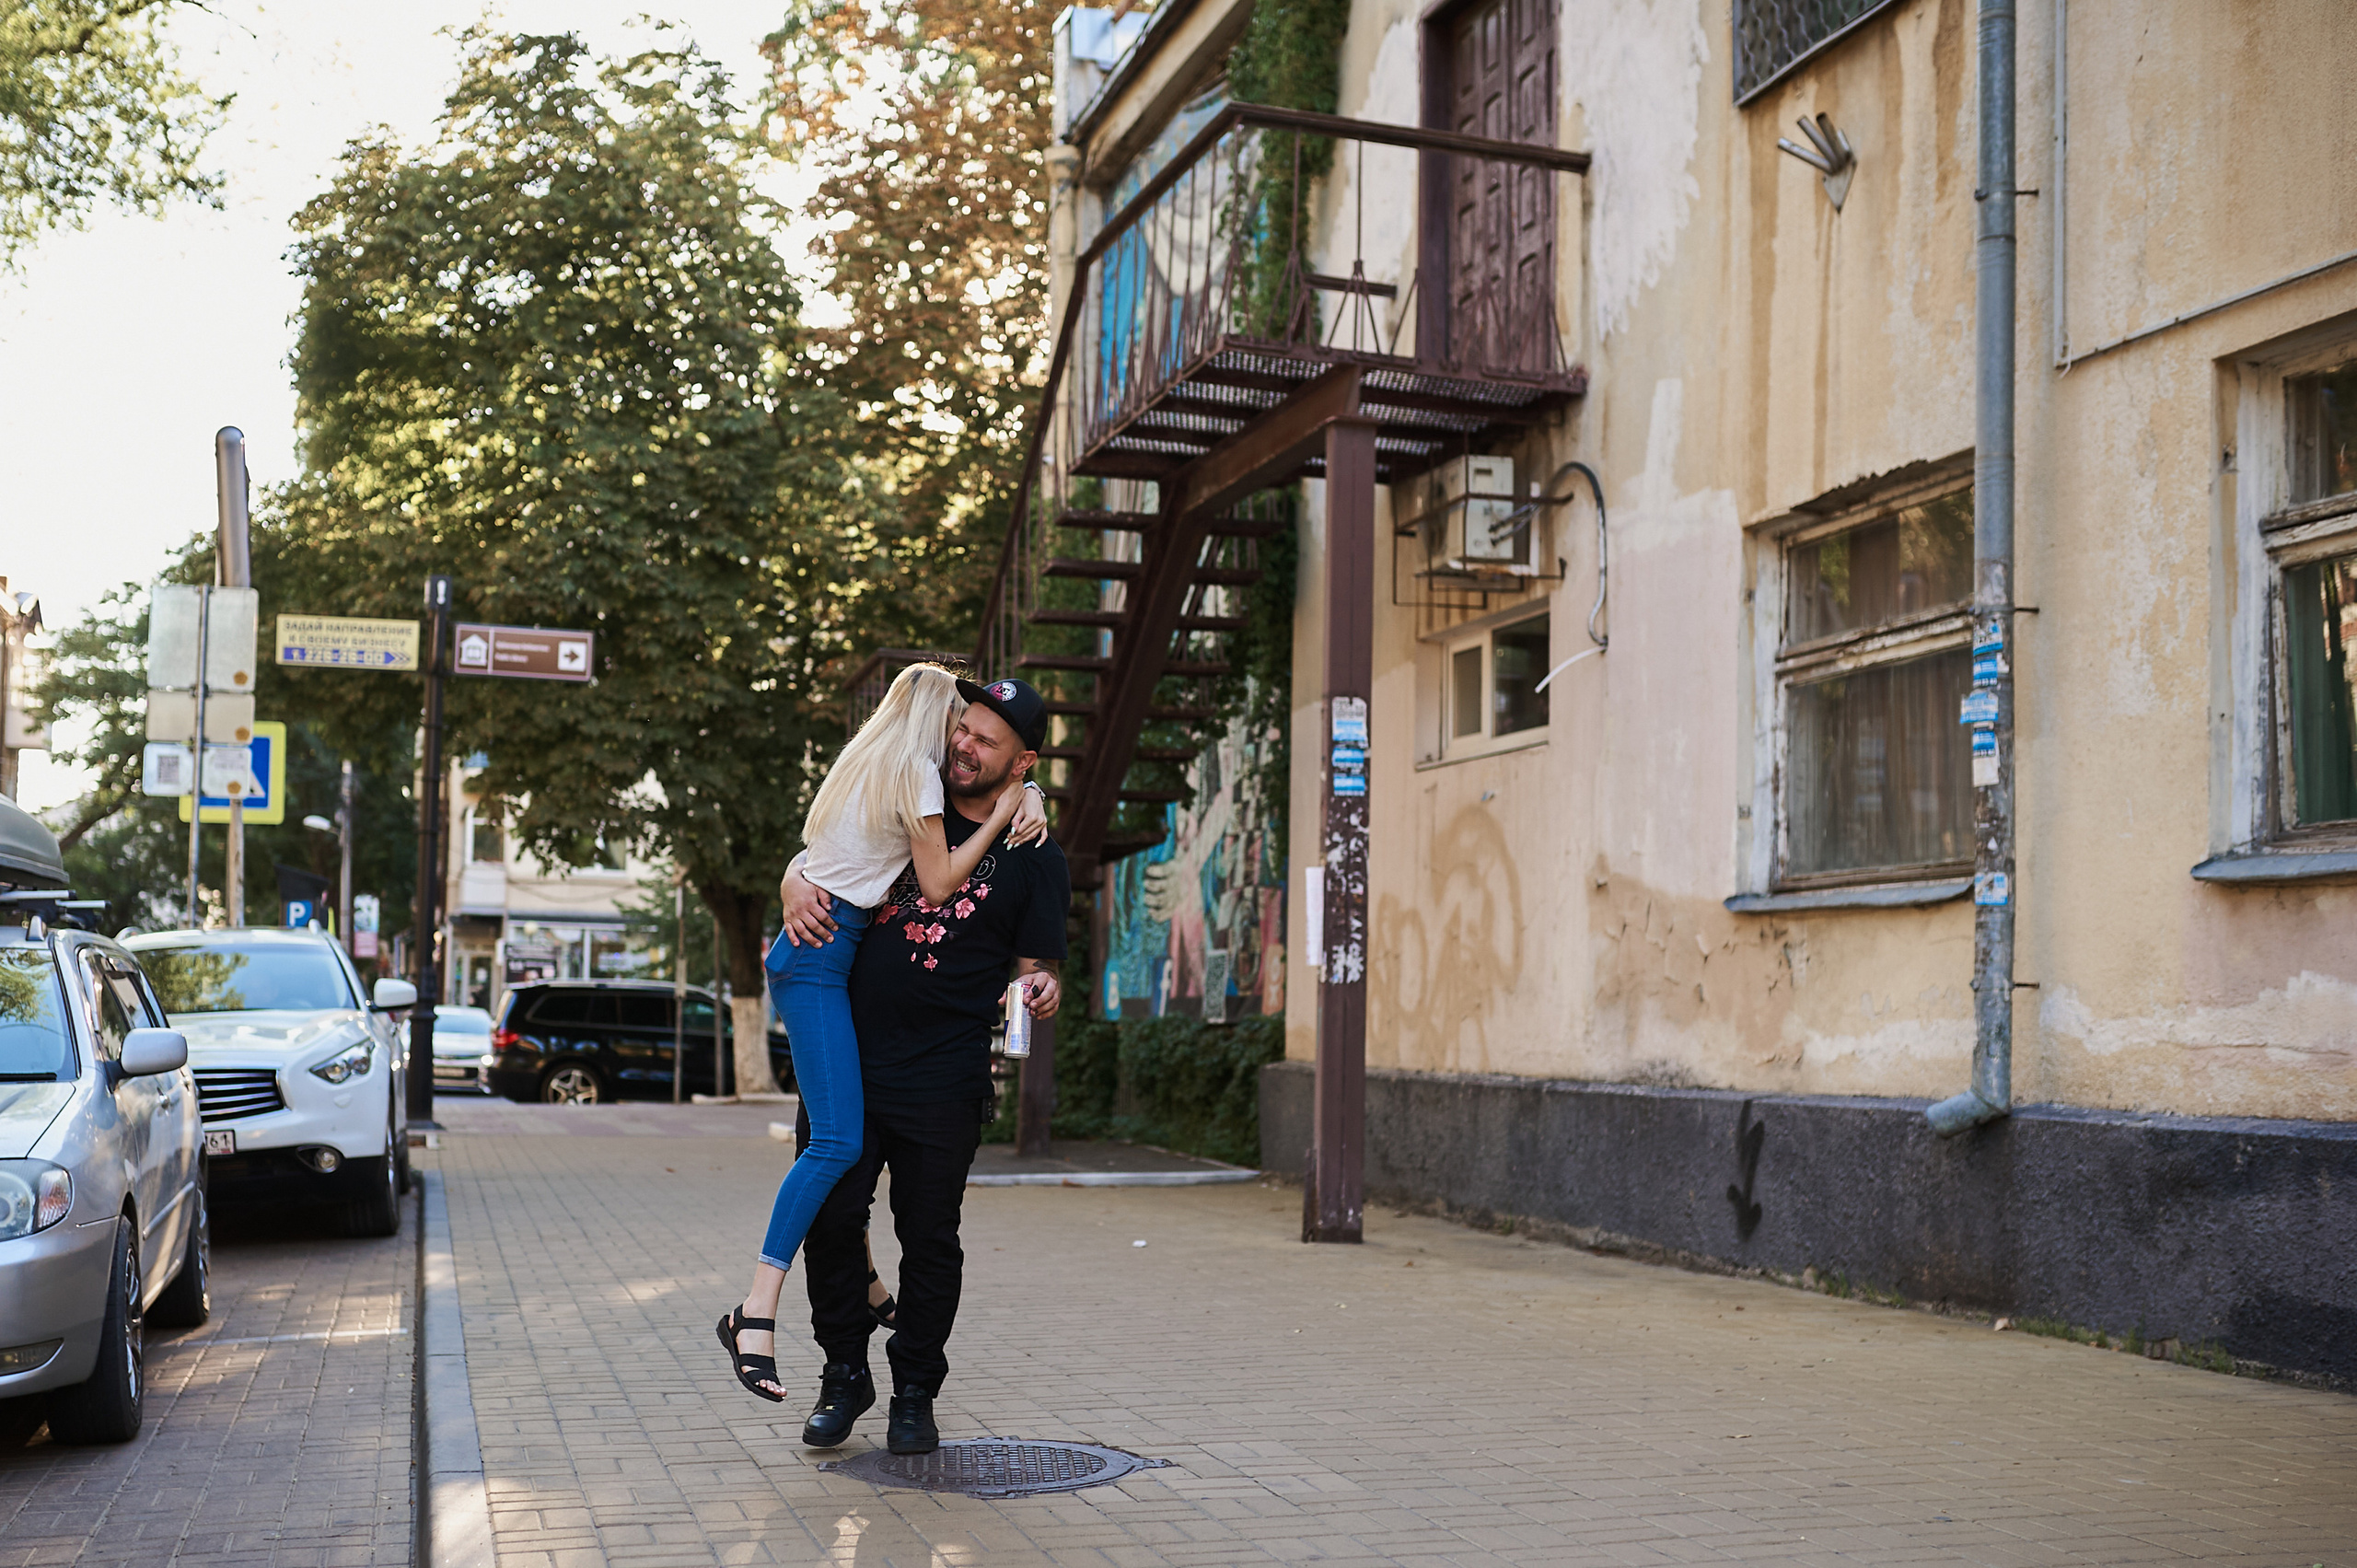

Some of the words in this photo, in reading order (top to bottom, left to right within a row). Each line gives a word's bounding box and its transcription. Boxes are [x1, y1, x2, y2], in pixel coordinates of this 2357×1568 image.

[284, 619, 322, 633] ЗАДАЙ
[326, 621, 412, 635] НАПРАВЛЕНИЕ
[299, 634, 348, 645] СВОЕМУ
[352, 637, 406, 647] БИЗНЕСУ
[289, 901, 306, 926] P
